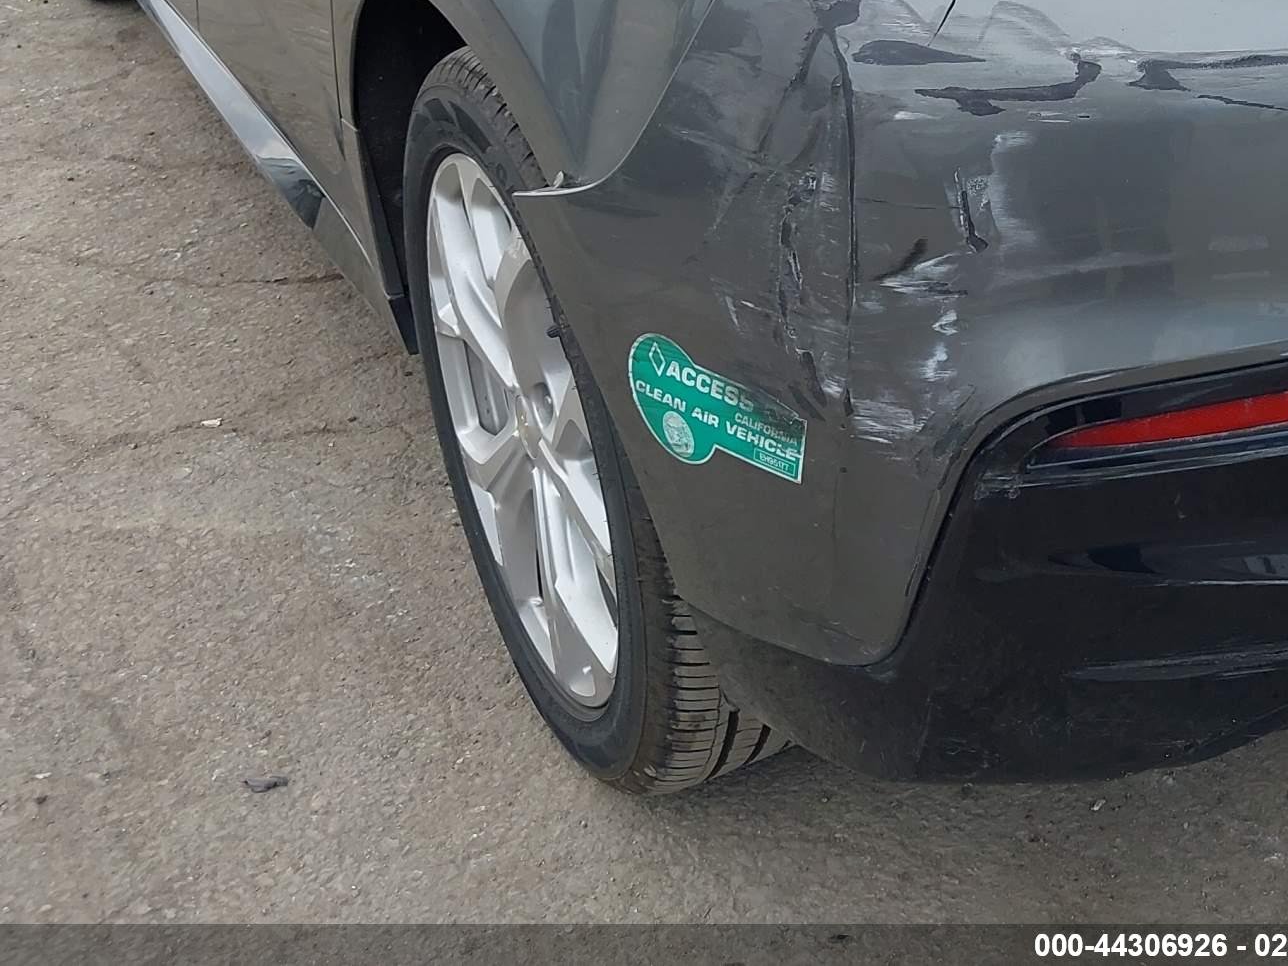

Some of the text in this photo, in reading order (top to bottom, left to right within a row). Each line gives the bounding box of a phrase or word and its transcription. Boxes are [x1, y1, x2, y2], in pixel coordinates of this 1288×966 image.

[635, 379, 800, 462] CLEAN AIR VEHICLE
[666, 360, 754, 413] ACCESS
